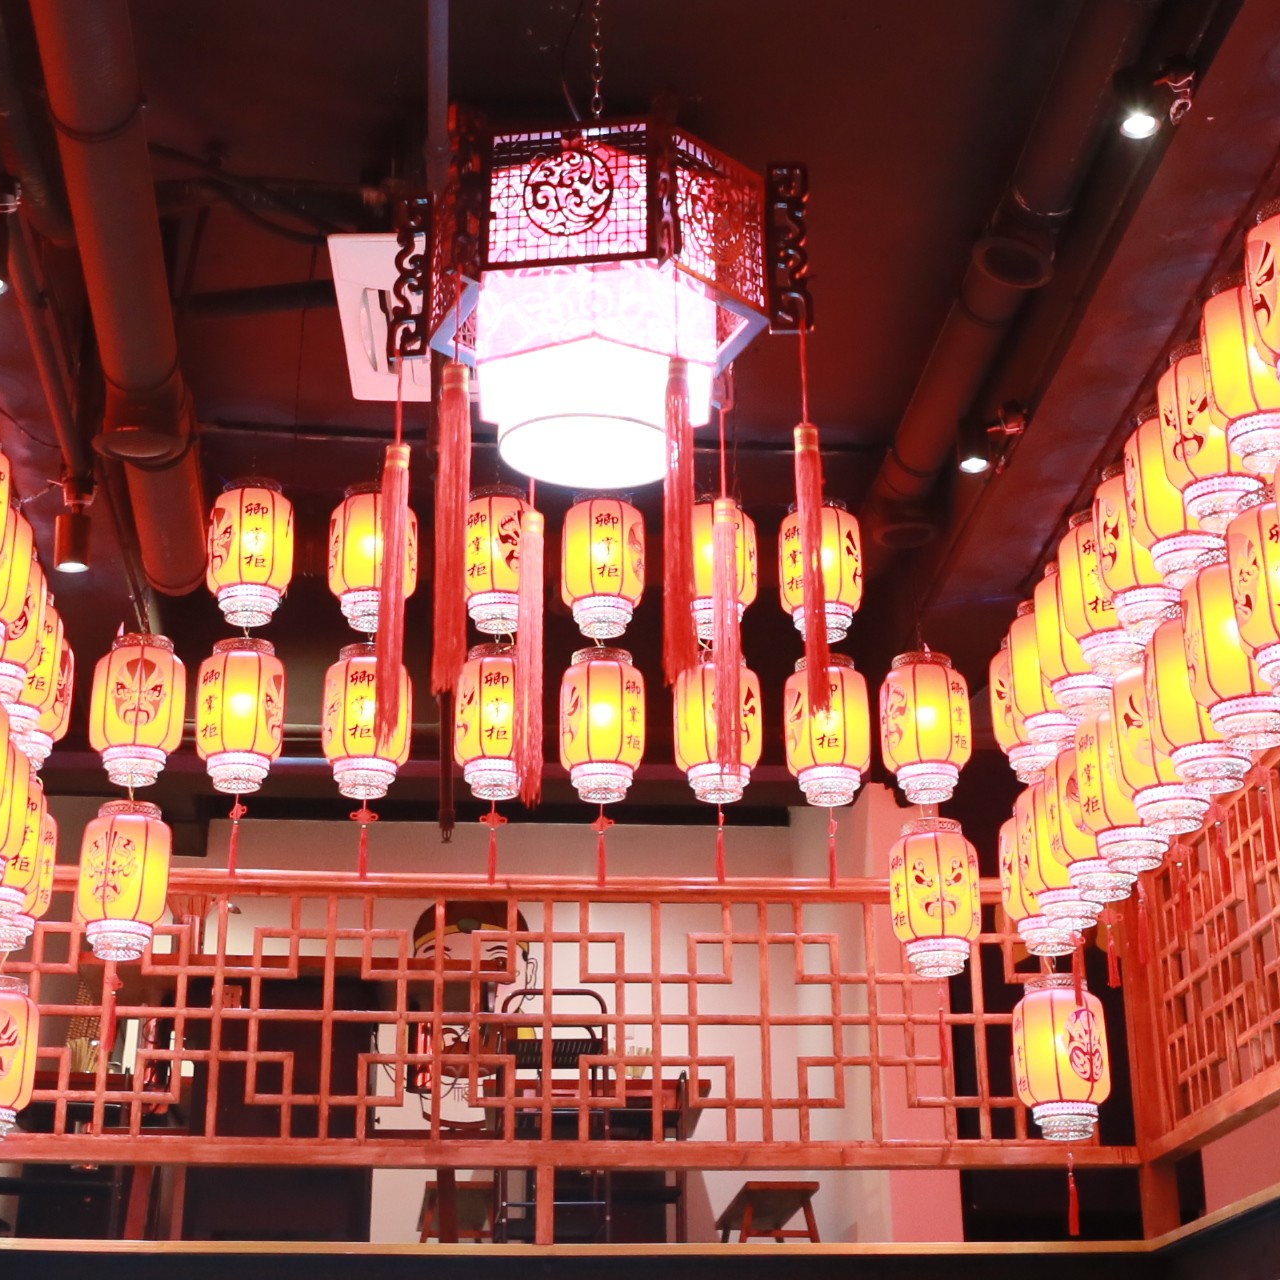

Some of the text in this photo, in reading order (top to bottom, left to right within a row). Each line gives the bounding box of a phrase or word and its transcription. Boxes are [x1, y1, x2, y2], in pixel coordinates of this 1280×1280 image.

[243, 501, 269, 568] 卿掌柜
[467, 512, 488, 577] 卿掌柜
[594, 513, 619, 578] 卿掌柜
[200, 669, 221, 738] 卿掌柜
[483, 671, 510, 741] 卿掌柜
[625, 679, 642, 750] 卿掌柜
[1078, 734, 1101, 816] 卿掌柜
